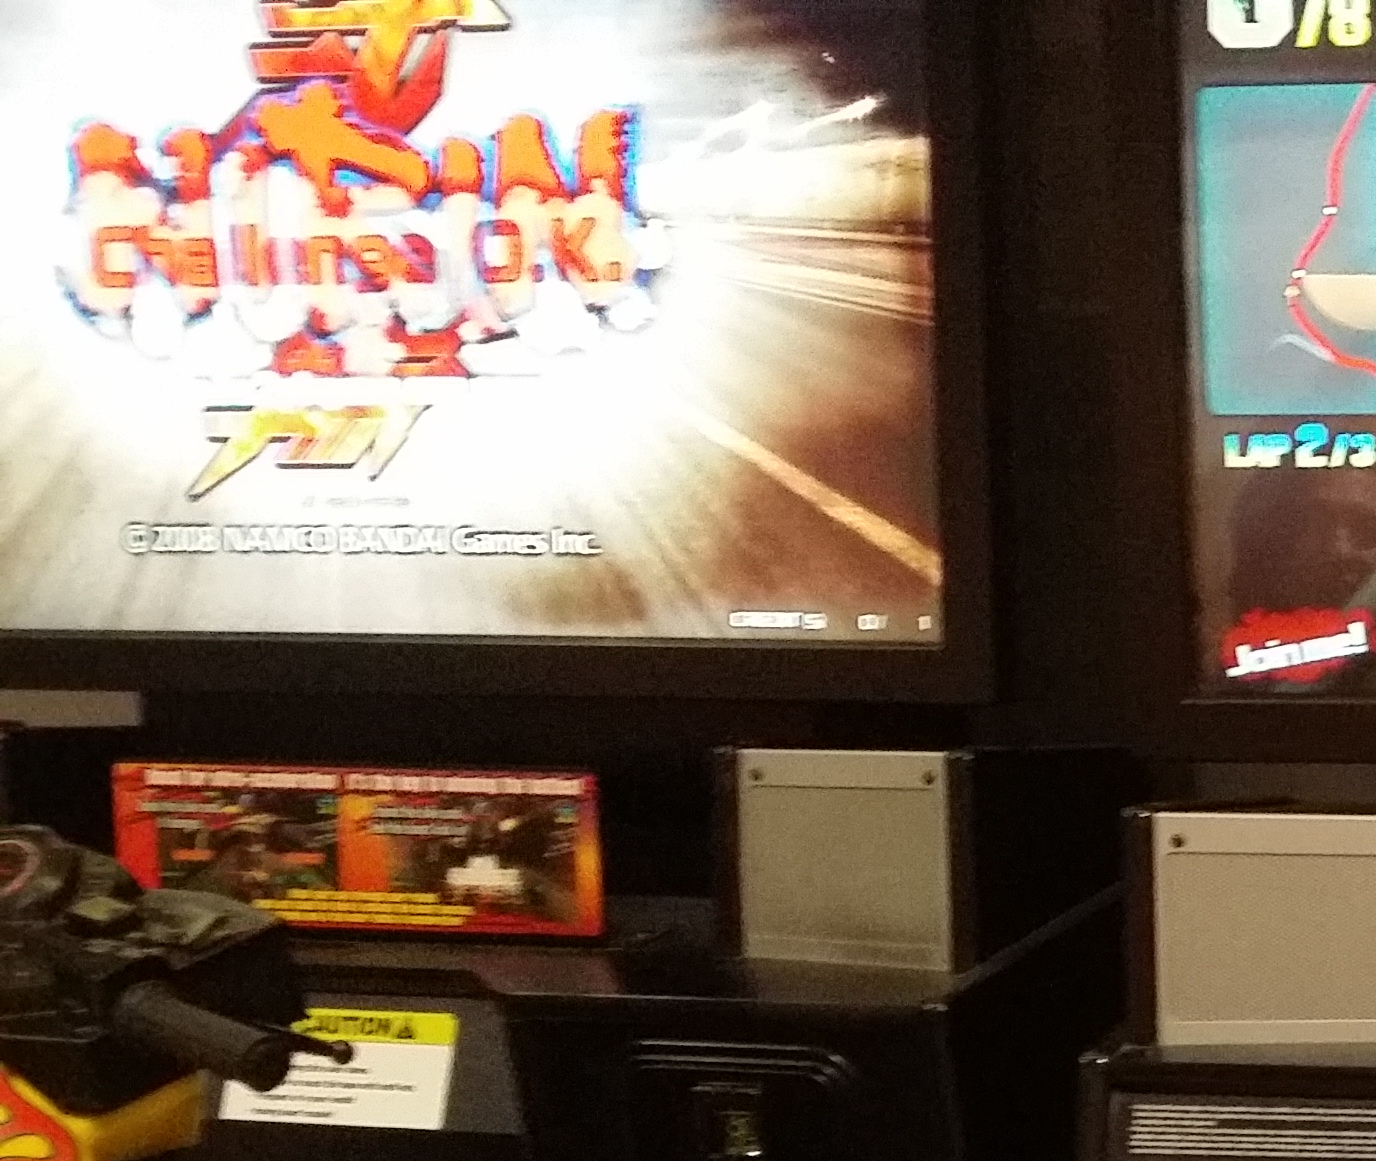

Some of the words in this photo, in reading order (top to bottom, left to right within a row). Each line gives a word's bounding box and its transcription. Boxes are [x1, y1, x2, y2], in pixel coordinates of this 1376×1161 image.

[222, 525, 336, 554] NAMCO
[338, 525, 448, 554] BANDAI
[452, 525, 548, 555] Games
